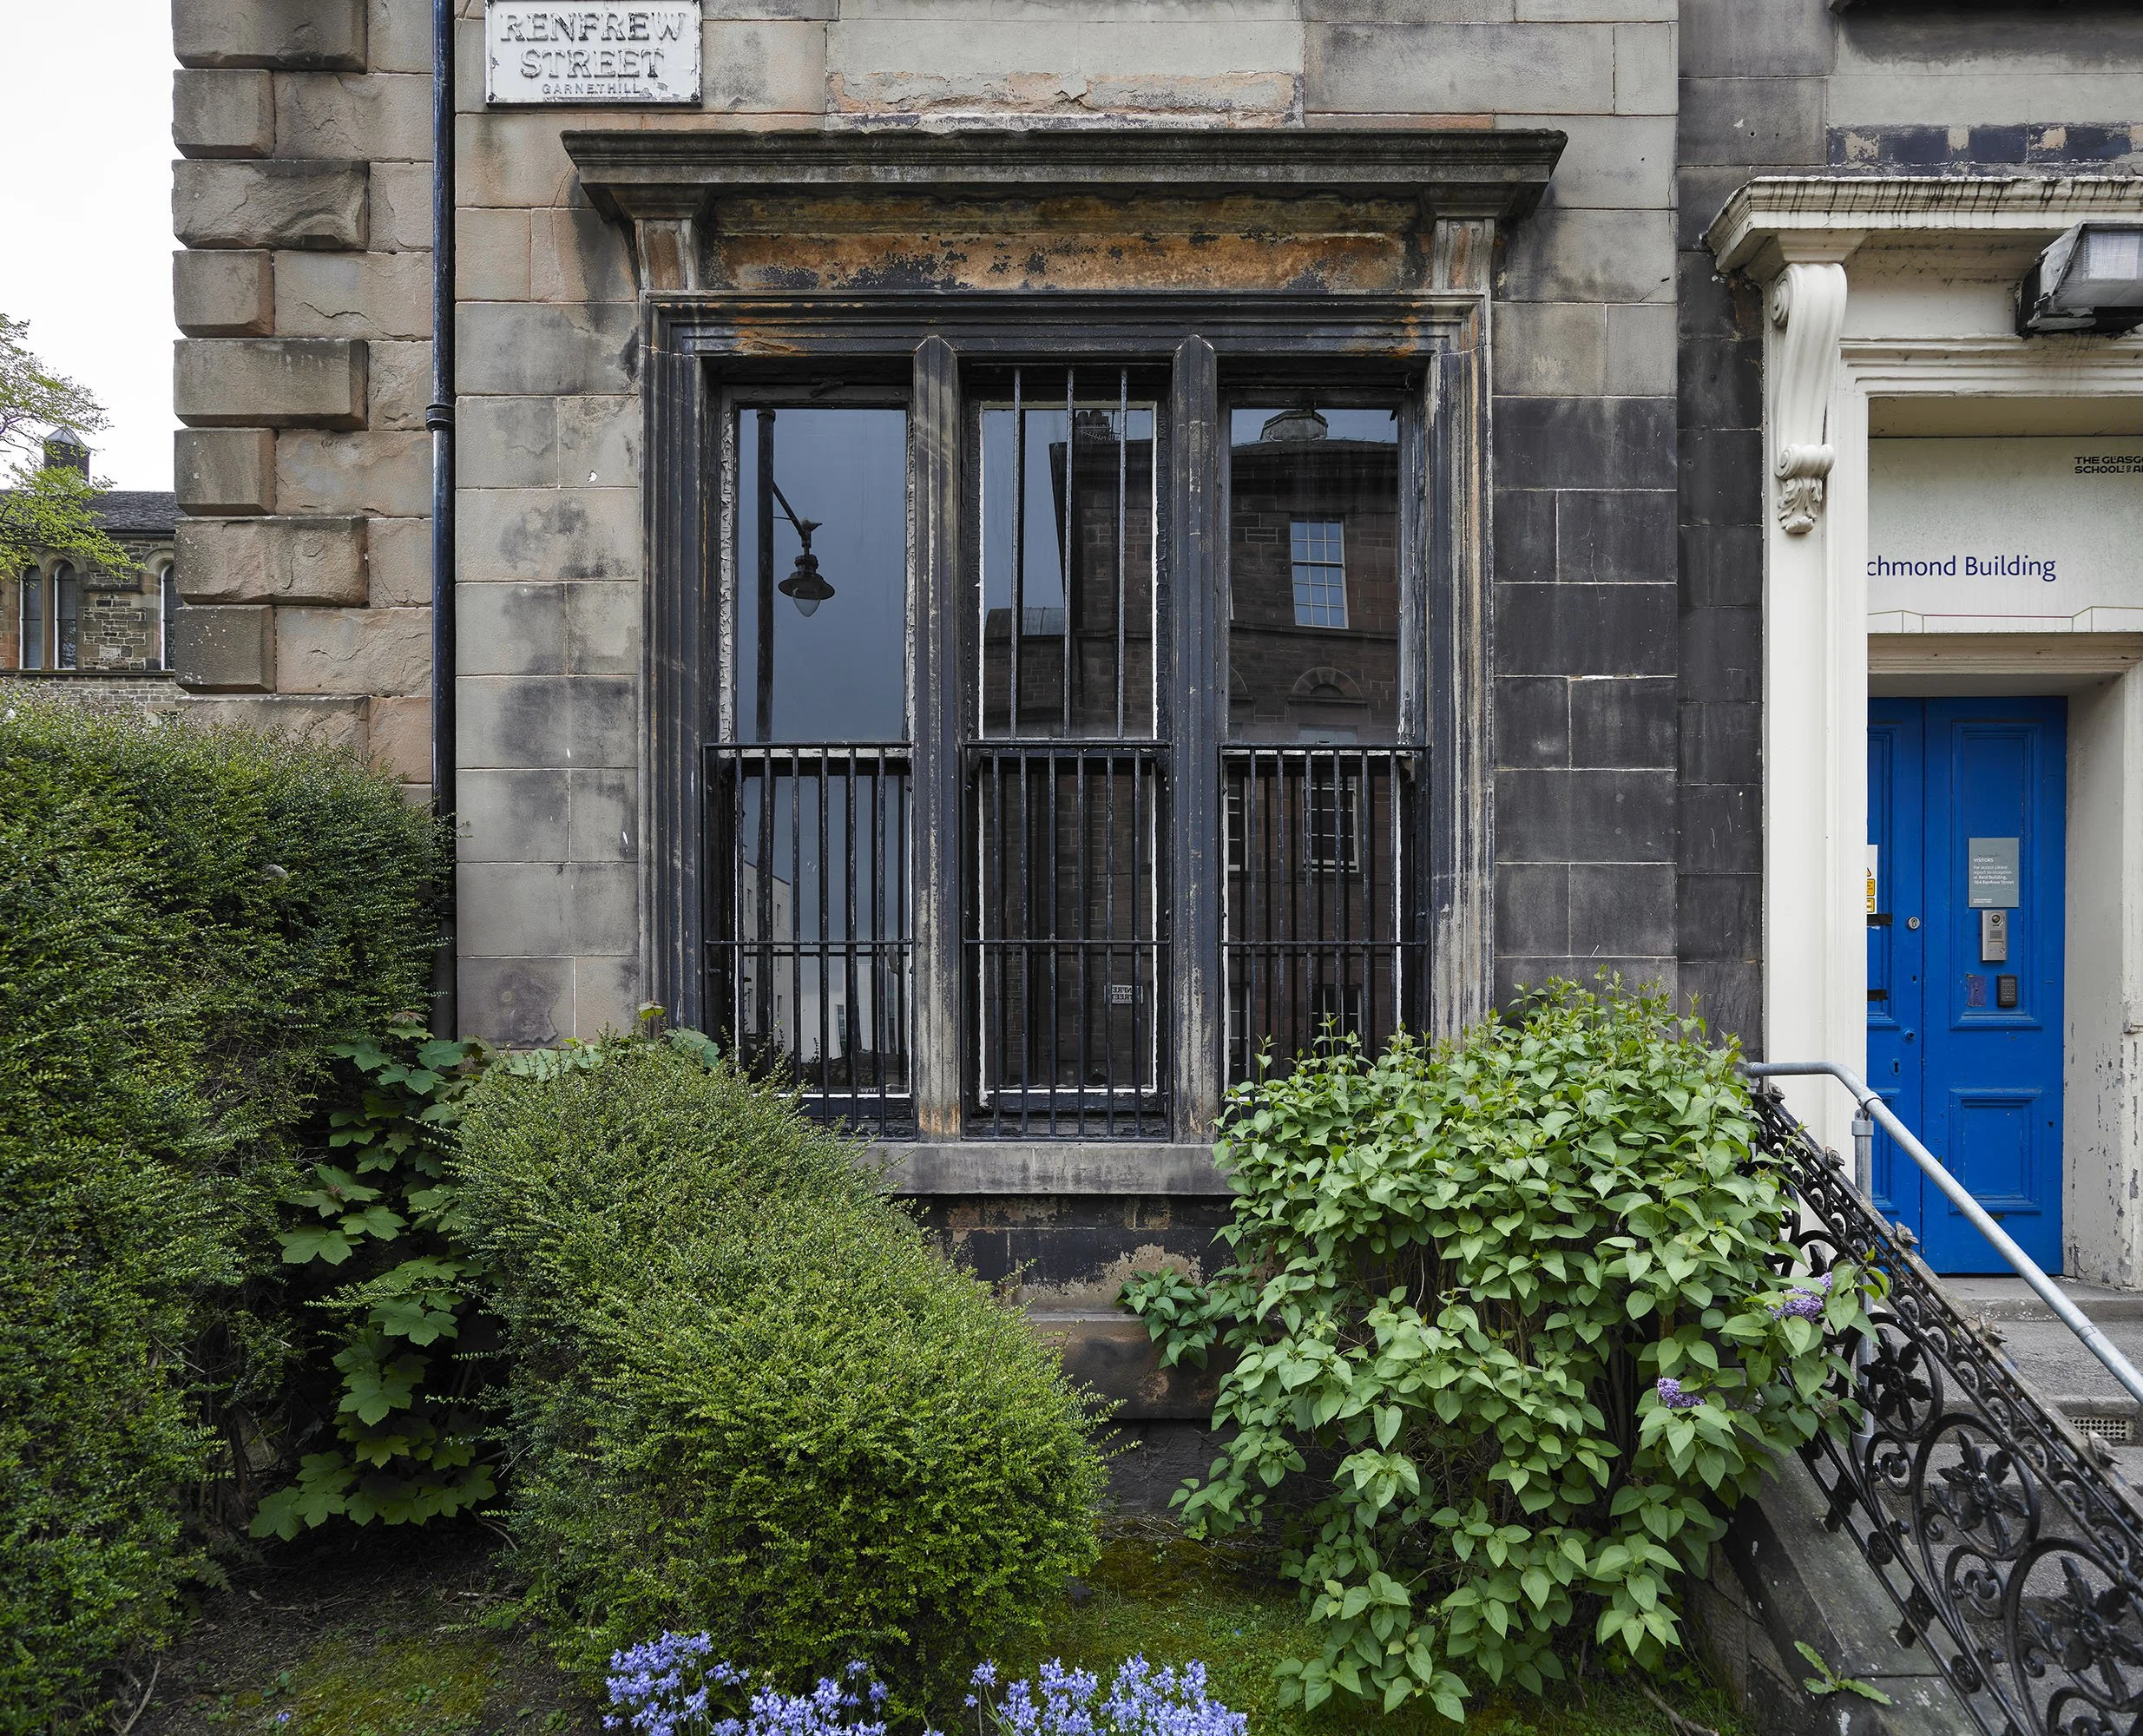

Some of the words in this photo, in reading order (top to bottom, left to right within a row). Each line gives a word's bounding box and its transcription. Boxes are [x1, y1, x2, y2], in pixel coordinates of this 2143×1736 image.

[500, 12, 686, 42] RENFREW
[520, 49, 664, 78] STREET
[542, 83, 641, 95] GARNETHILL
[2074, 465, 2125, 474] SCHOOL
[2102, 456, 2143, 464] GLASG
[1965, 555, 2056, 582] Building
